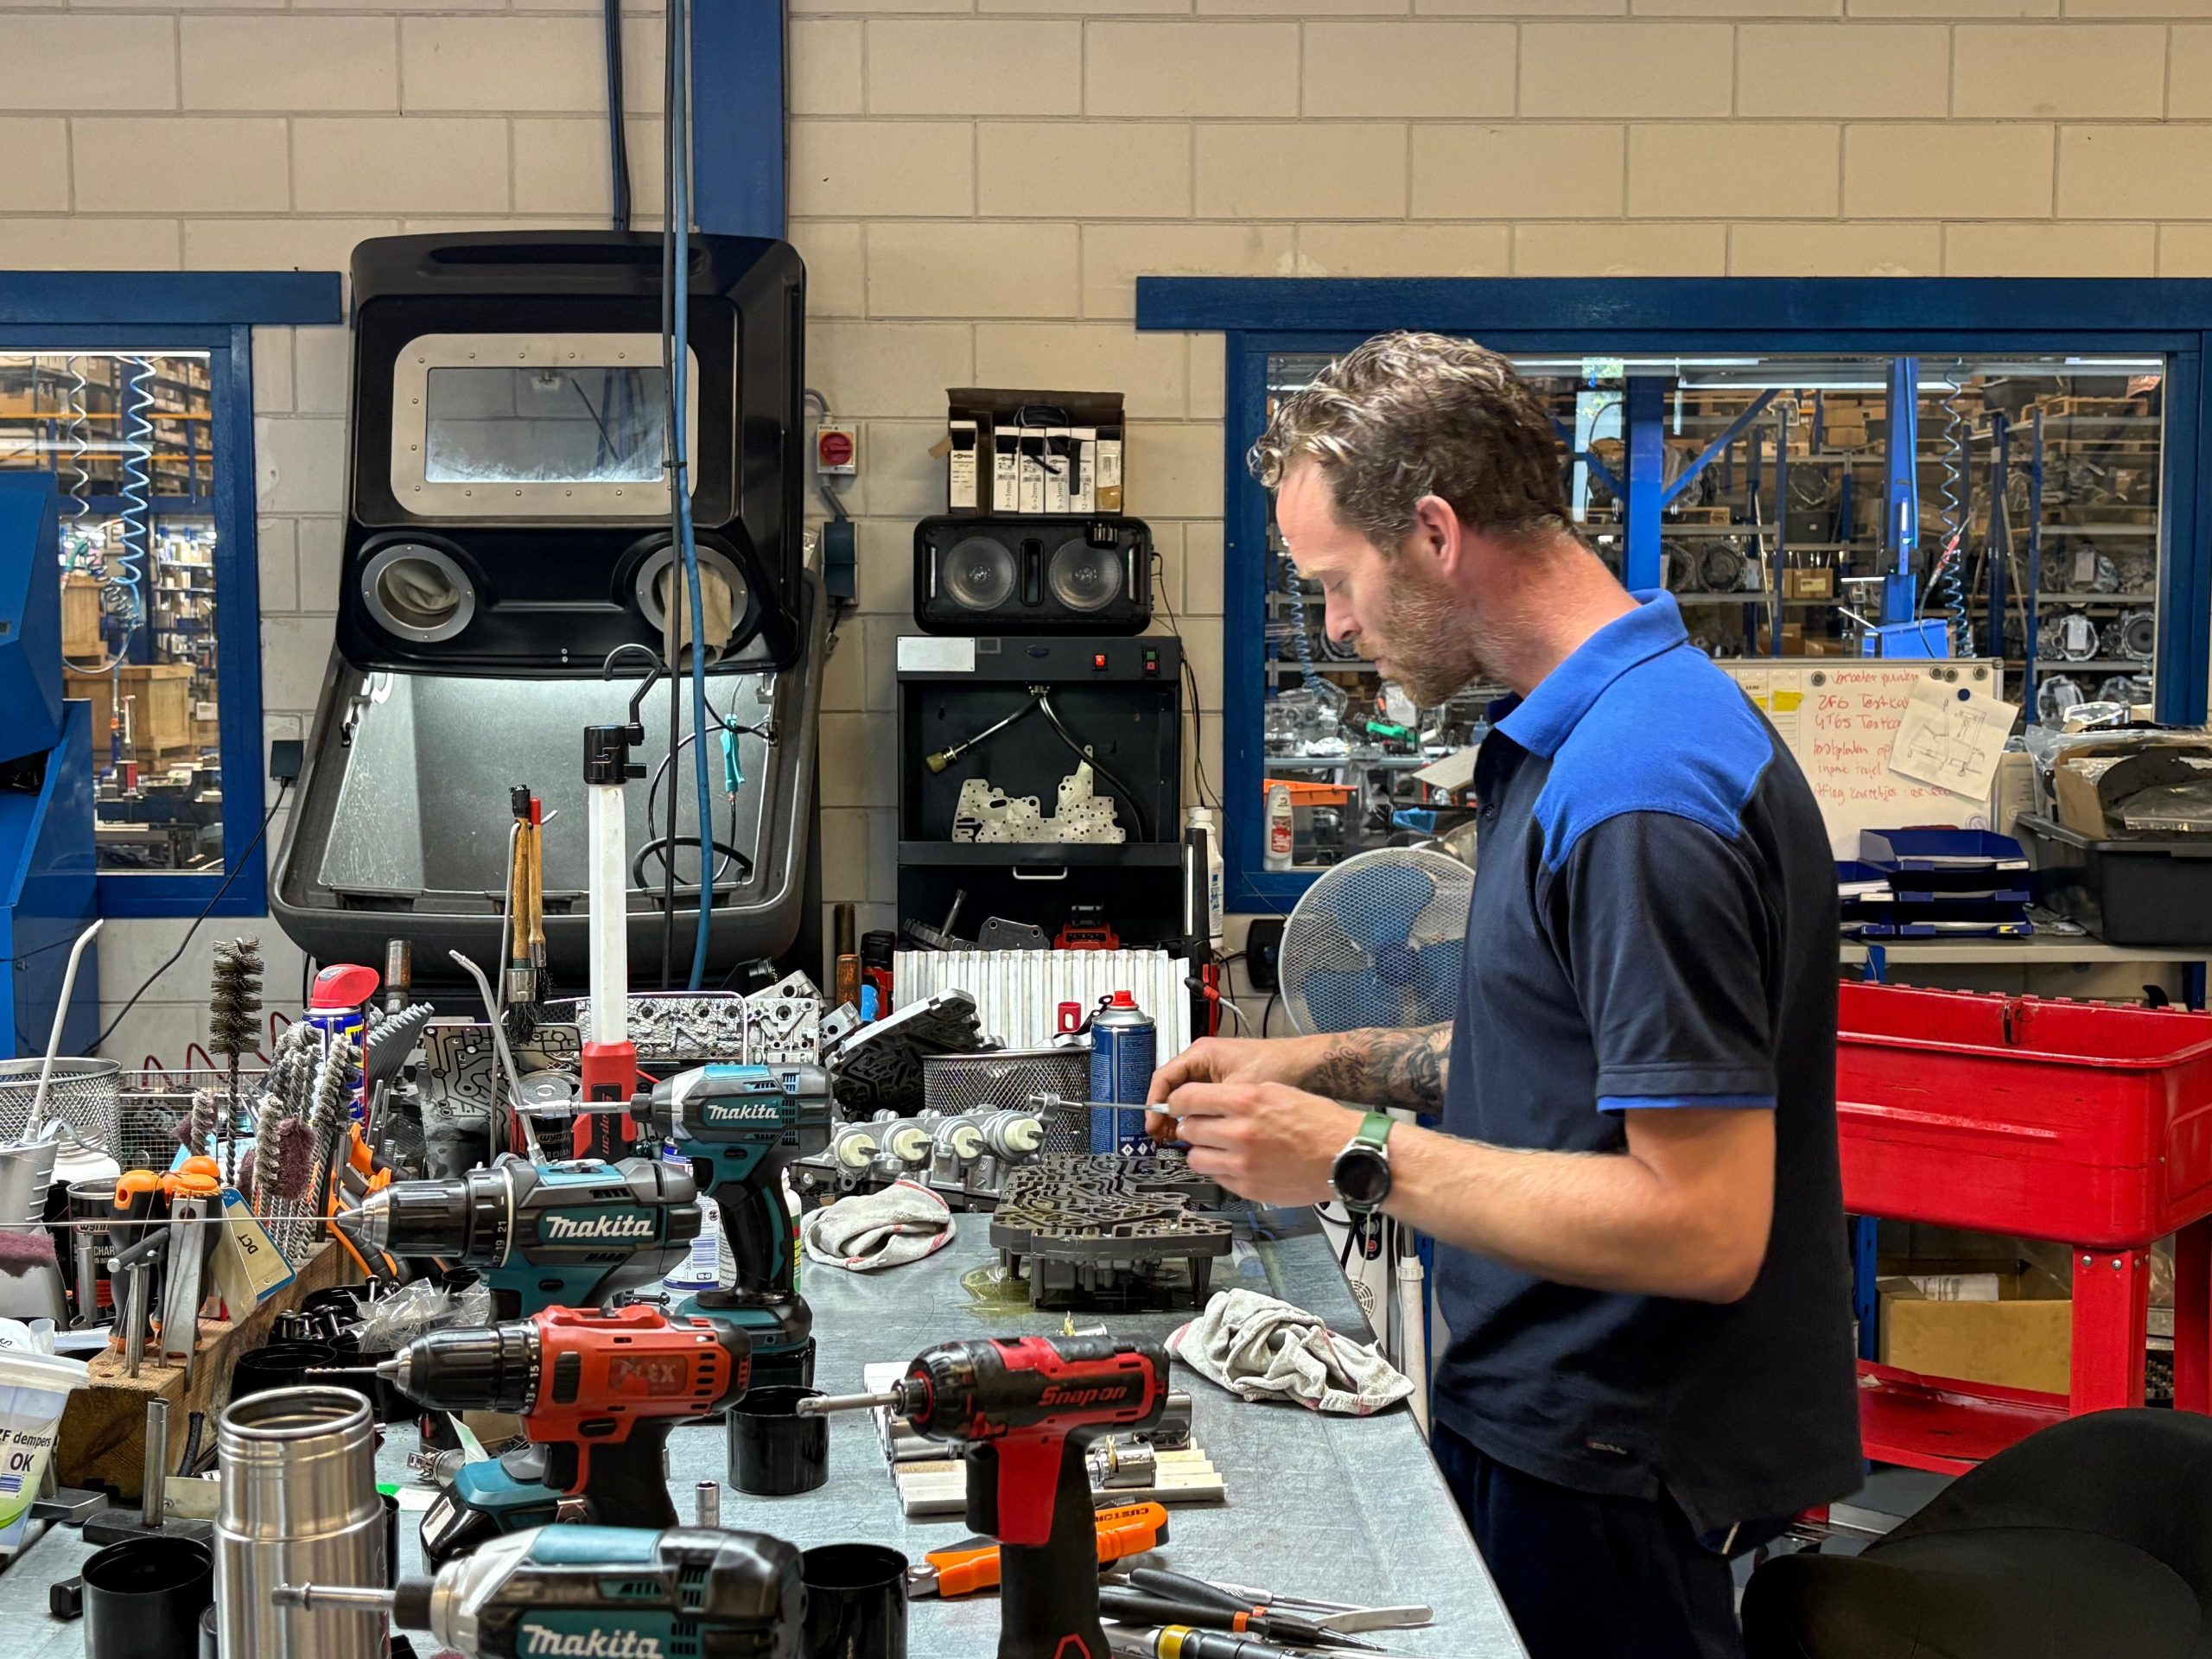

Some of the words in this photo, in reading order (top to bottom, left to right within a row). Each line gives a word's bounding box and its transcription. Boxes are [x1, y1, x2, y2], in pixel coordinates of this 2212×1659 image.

[498, 1221, 507, 1233] 21
[237, 1233, 259, 1255] DCT
[529, 1365, 540, 1378] 15
[1037, 1386, 1128, 1407] Snap-on
[13, 1431, 52, 1449] dempers
[10, 1452, 35, 1471] OK
